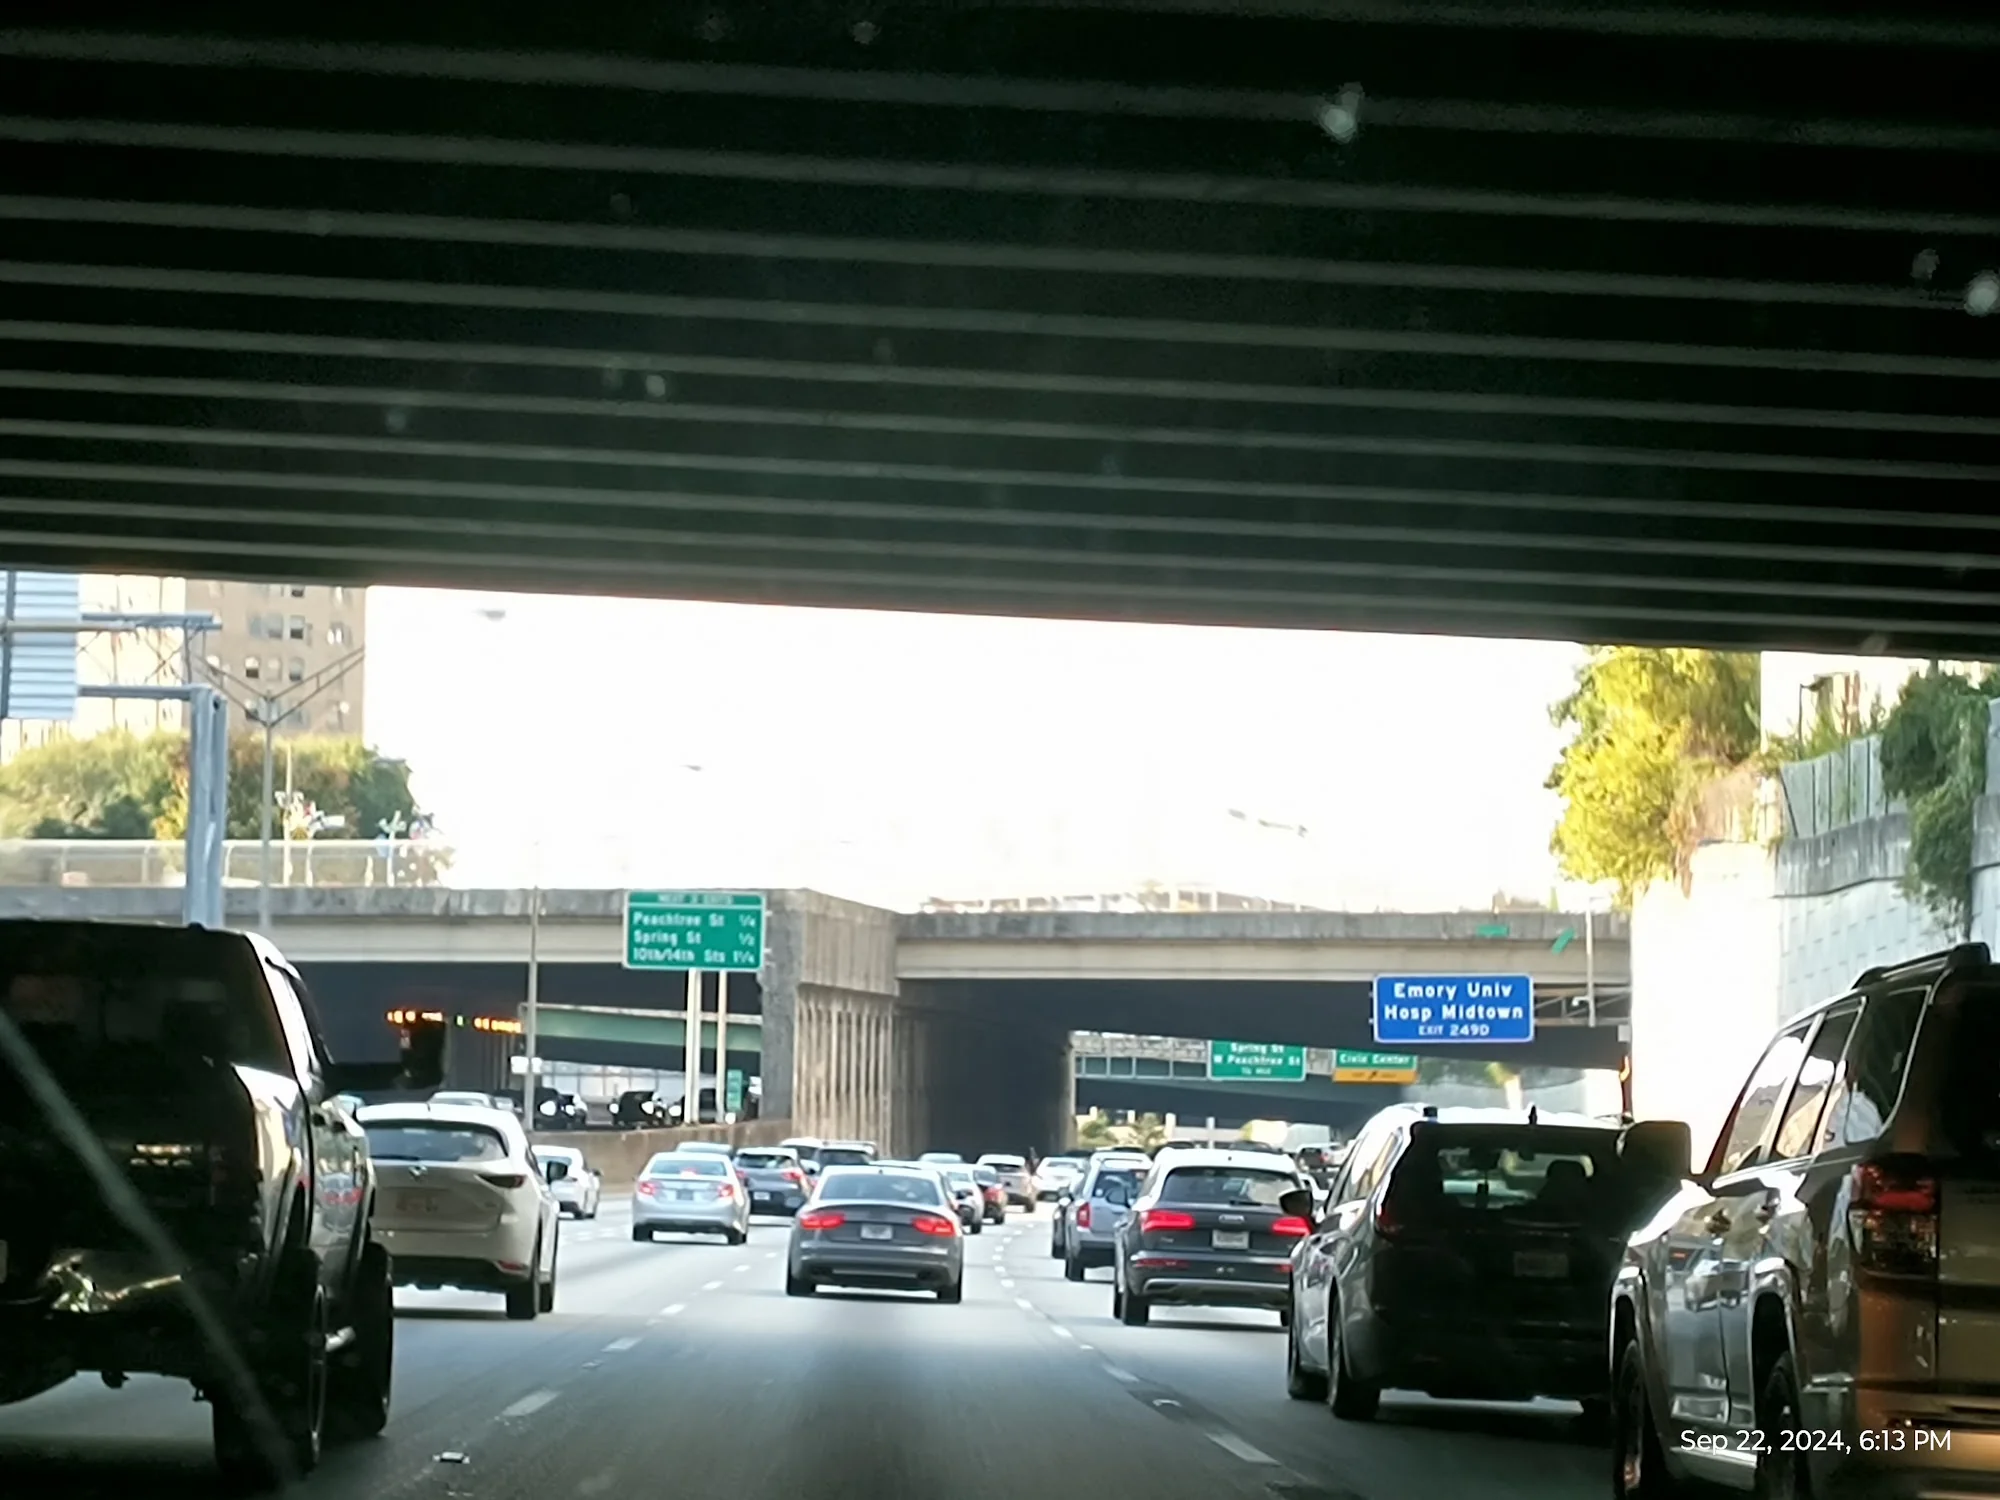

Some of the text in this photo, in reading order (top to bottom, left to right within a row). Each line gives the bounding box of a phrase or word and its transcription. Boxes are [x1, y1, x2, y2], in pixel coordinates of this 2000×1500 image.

[632, 911, 702, 926] Peachtree
[708, 913, 725, 928] St
[633, 929, 678, 947] Spring
[686, 930, 702, 945] St
[704, 949, 726, 963] Sts
[1393, 982, 1512, 1000] Emory Univ
[1384, 1004, 1523, 1022] Hosp Midtown
[1418, 1024, 1490, 1036] EXIT 249D
[1230, 1042, 1267, 1054] Spring
